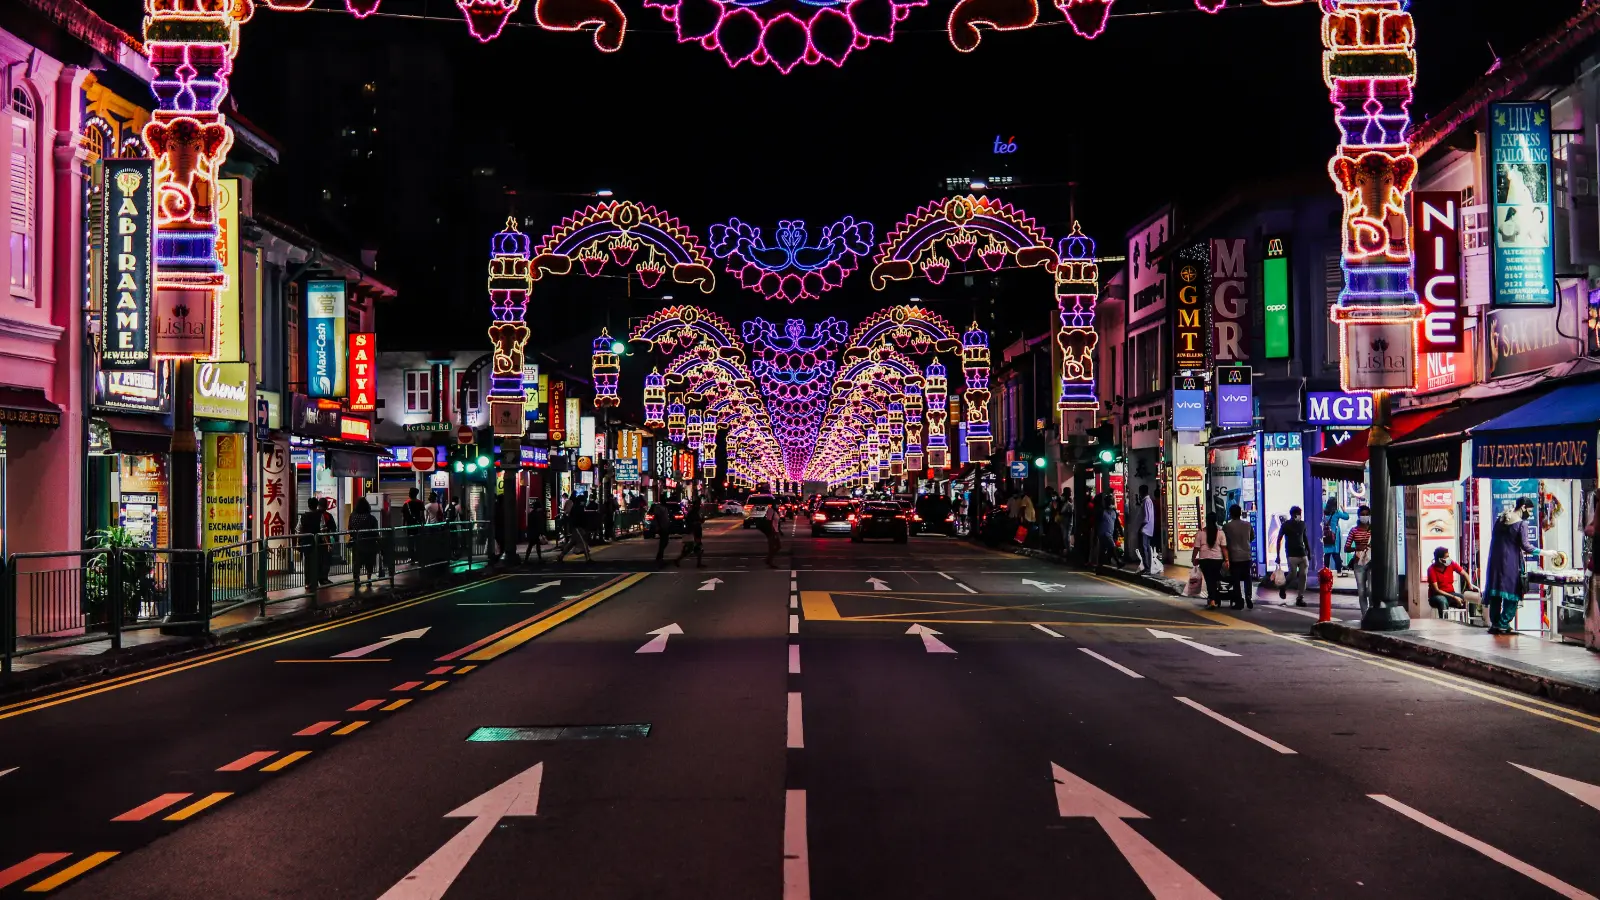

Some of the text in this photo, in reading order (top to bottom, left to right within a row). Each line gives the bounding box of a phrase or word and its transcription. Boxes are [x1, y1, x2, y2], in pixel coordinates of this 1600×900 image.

[1509, 107, 1532, 132] LILY
[116, 197, 139, 349] ABIRAAME
[1423, 200, 1456, 343] NICE
[1213, 239, 1250, 360] MGR
[1266, 304, 1286, 312] oppo
[1178, 285, 1202, 351] GMT
[103, 351, 149, 359] JEWELLERS
[316, 323, 327, 375] Maxi-Cash
[1356, 351, 1405, 369] Lisha
[355, 335, 368, 404] SATYA
[1222, 394, 1248, 402] vivo
[1309, 396, 1373, 421] MGR
[1263, 434, 1301, 446] MGR
[1477, 440, 1588, 467] LILY EXPRESS TAILORING
[1266, 459, 1289, 468] OPPO
[1423, 452, 1449, 475] MOTORS
[206, 496, 217, 504] Old
[219, 496, 235, 504] Gold
[1214, 485, 1228, 497] 5G
[1423, 492, 1452, 503] NICE
[208, 523, 244, 531] EXCHANGE
[213, 535, 239, 543] REPAIR
